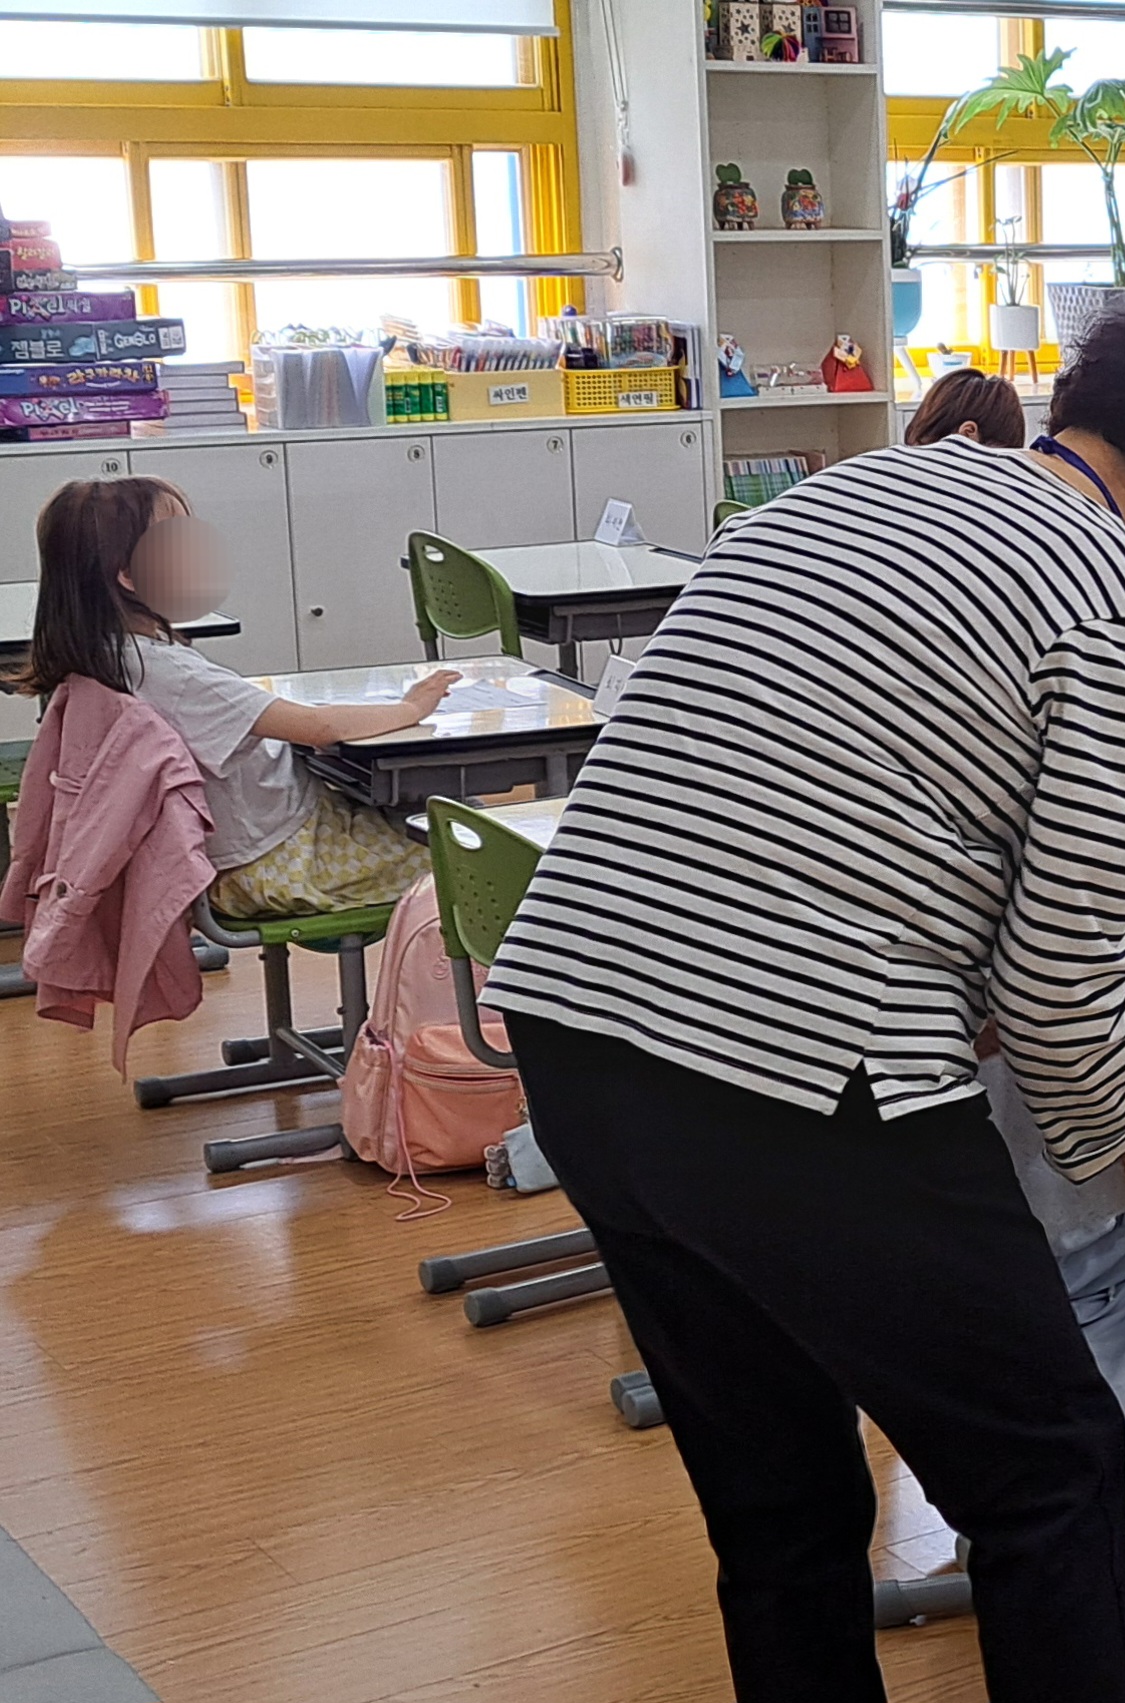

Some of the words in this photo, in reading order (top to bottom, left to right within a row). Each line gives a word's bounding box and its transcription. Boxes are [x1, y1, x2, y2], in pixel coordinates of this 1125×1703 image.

[493, 386, 527, 401] 싸인펜
[620, 392, 654, 406] 색연필
[105, 461, 118, 472] 10
